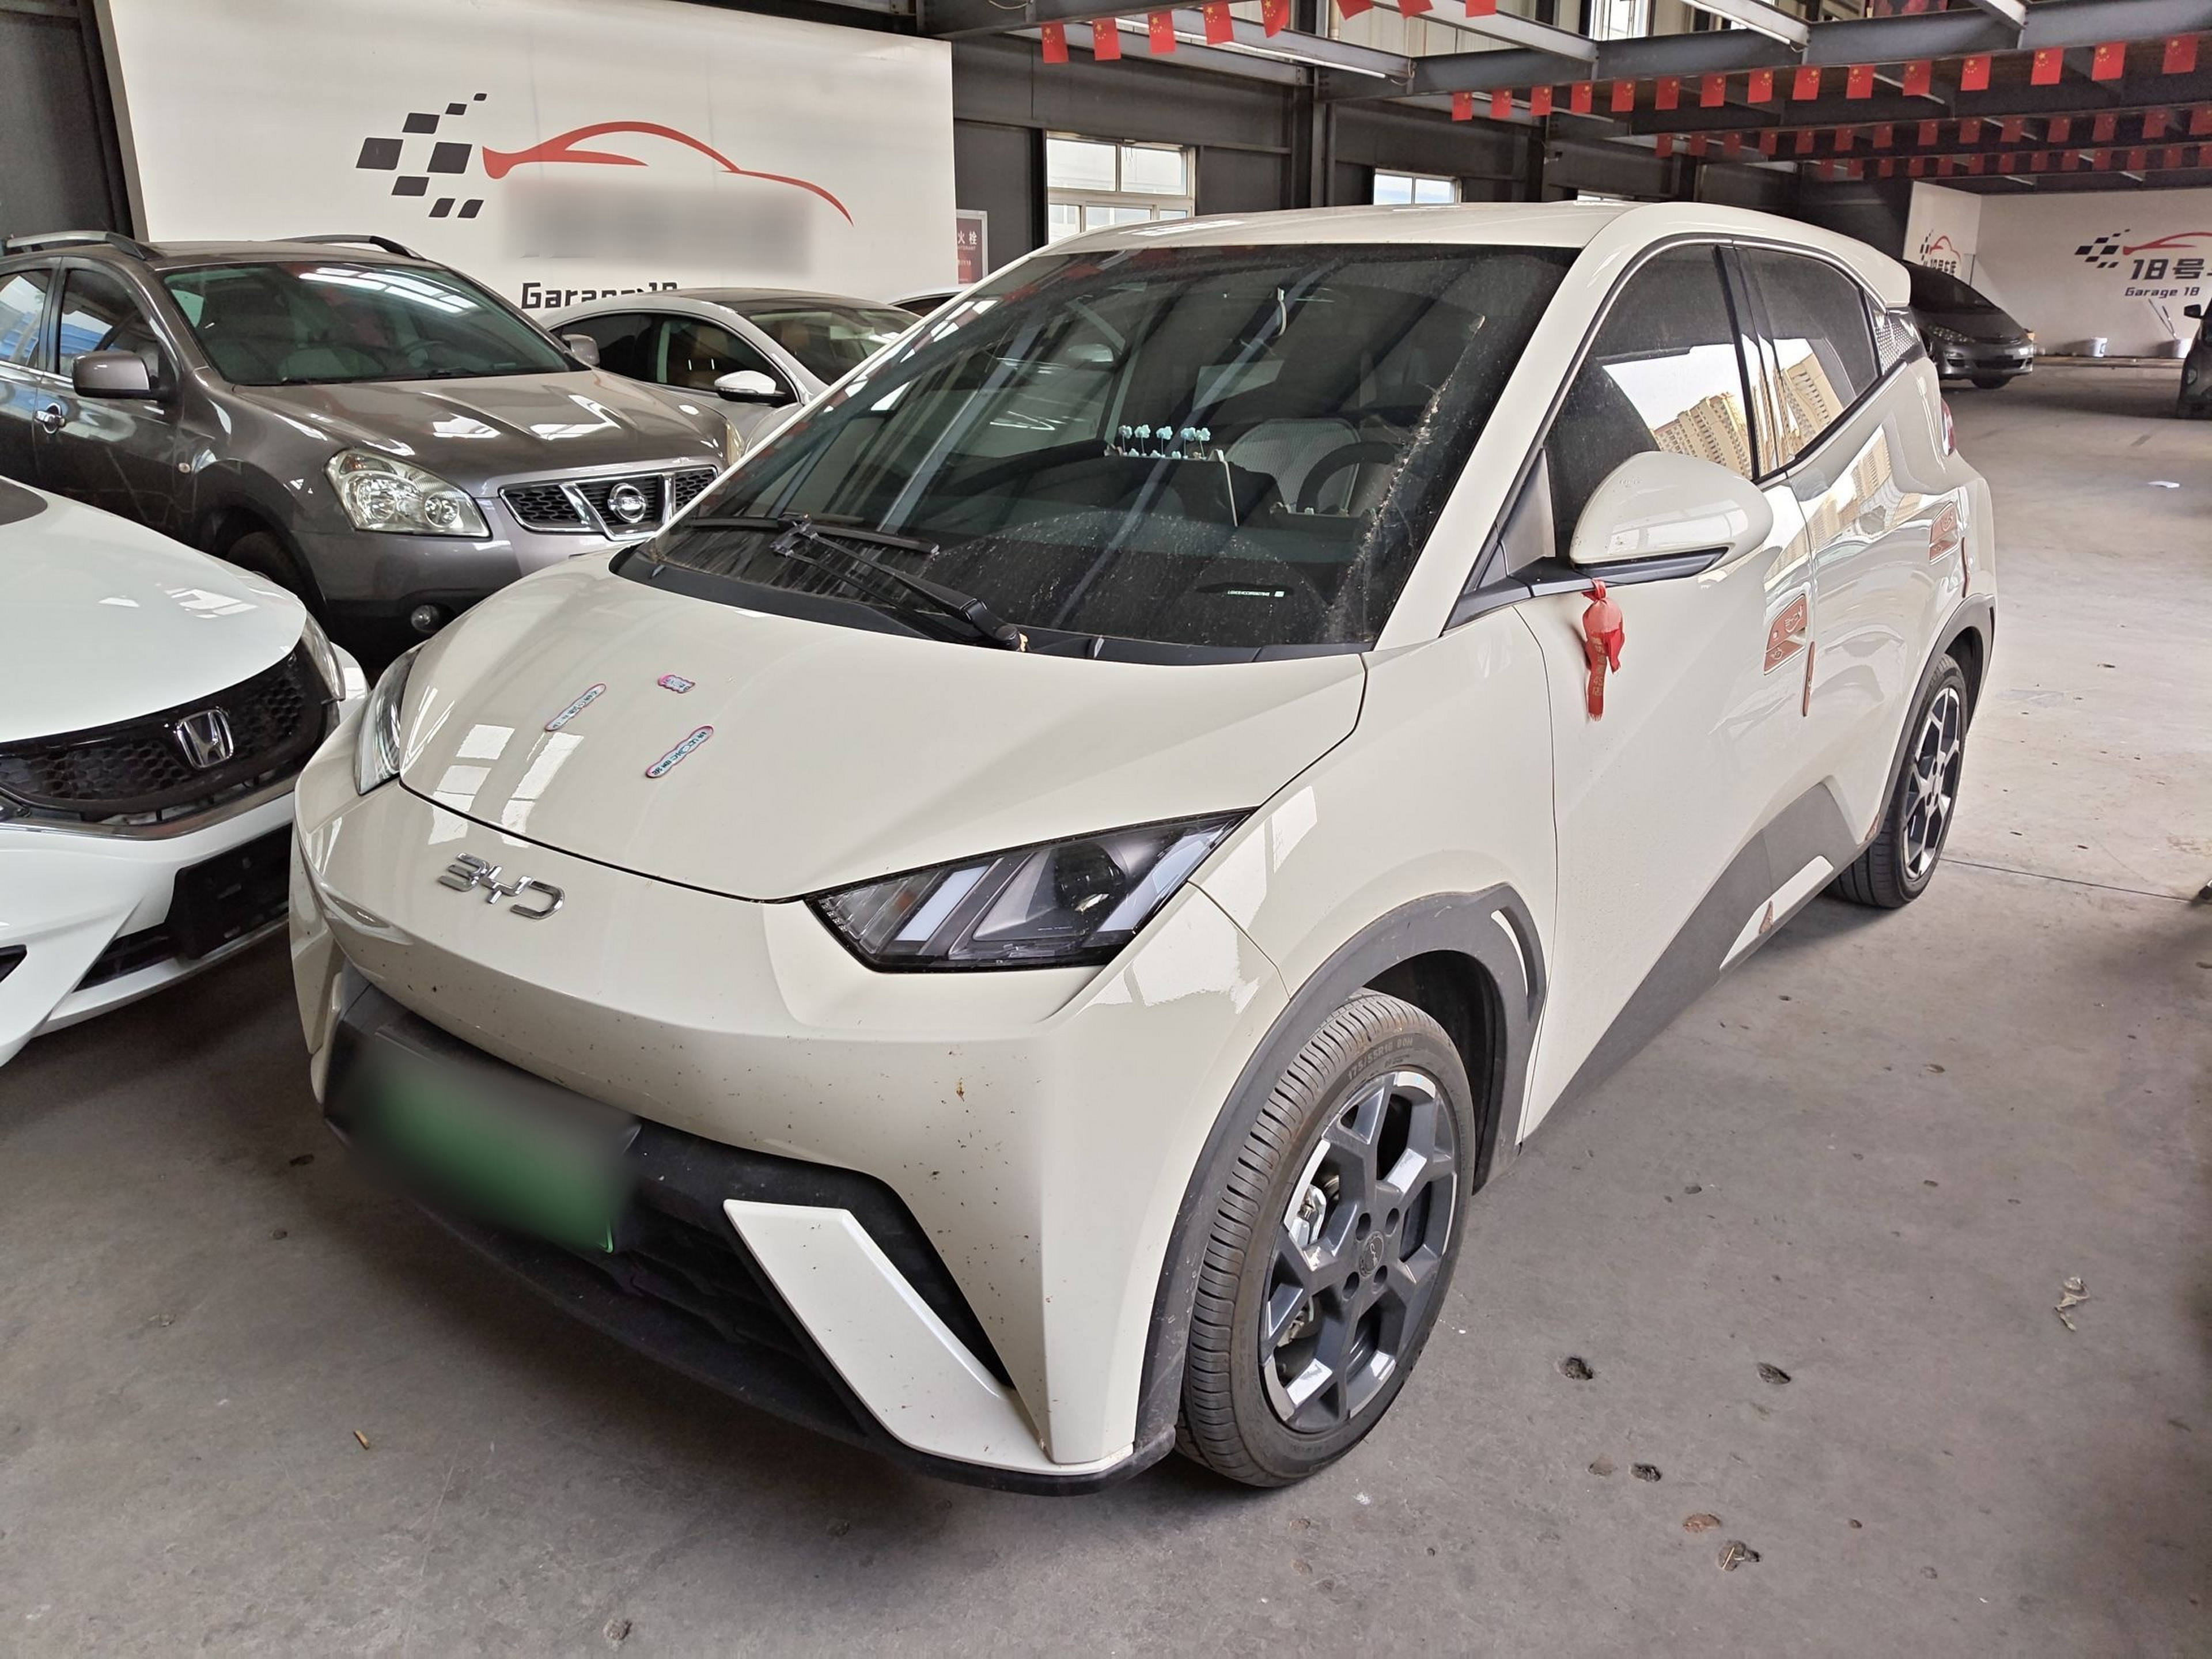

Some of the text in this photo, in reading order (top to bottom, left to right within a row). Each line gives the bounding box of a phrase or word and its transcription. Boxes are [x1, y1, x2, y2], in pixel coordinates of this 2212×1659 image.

[2130, 258, 2212, 280] 18号
[2124, 286, 2200, 299] Garage 18
[437, 853, 566, 919] BYD
